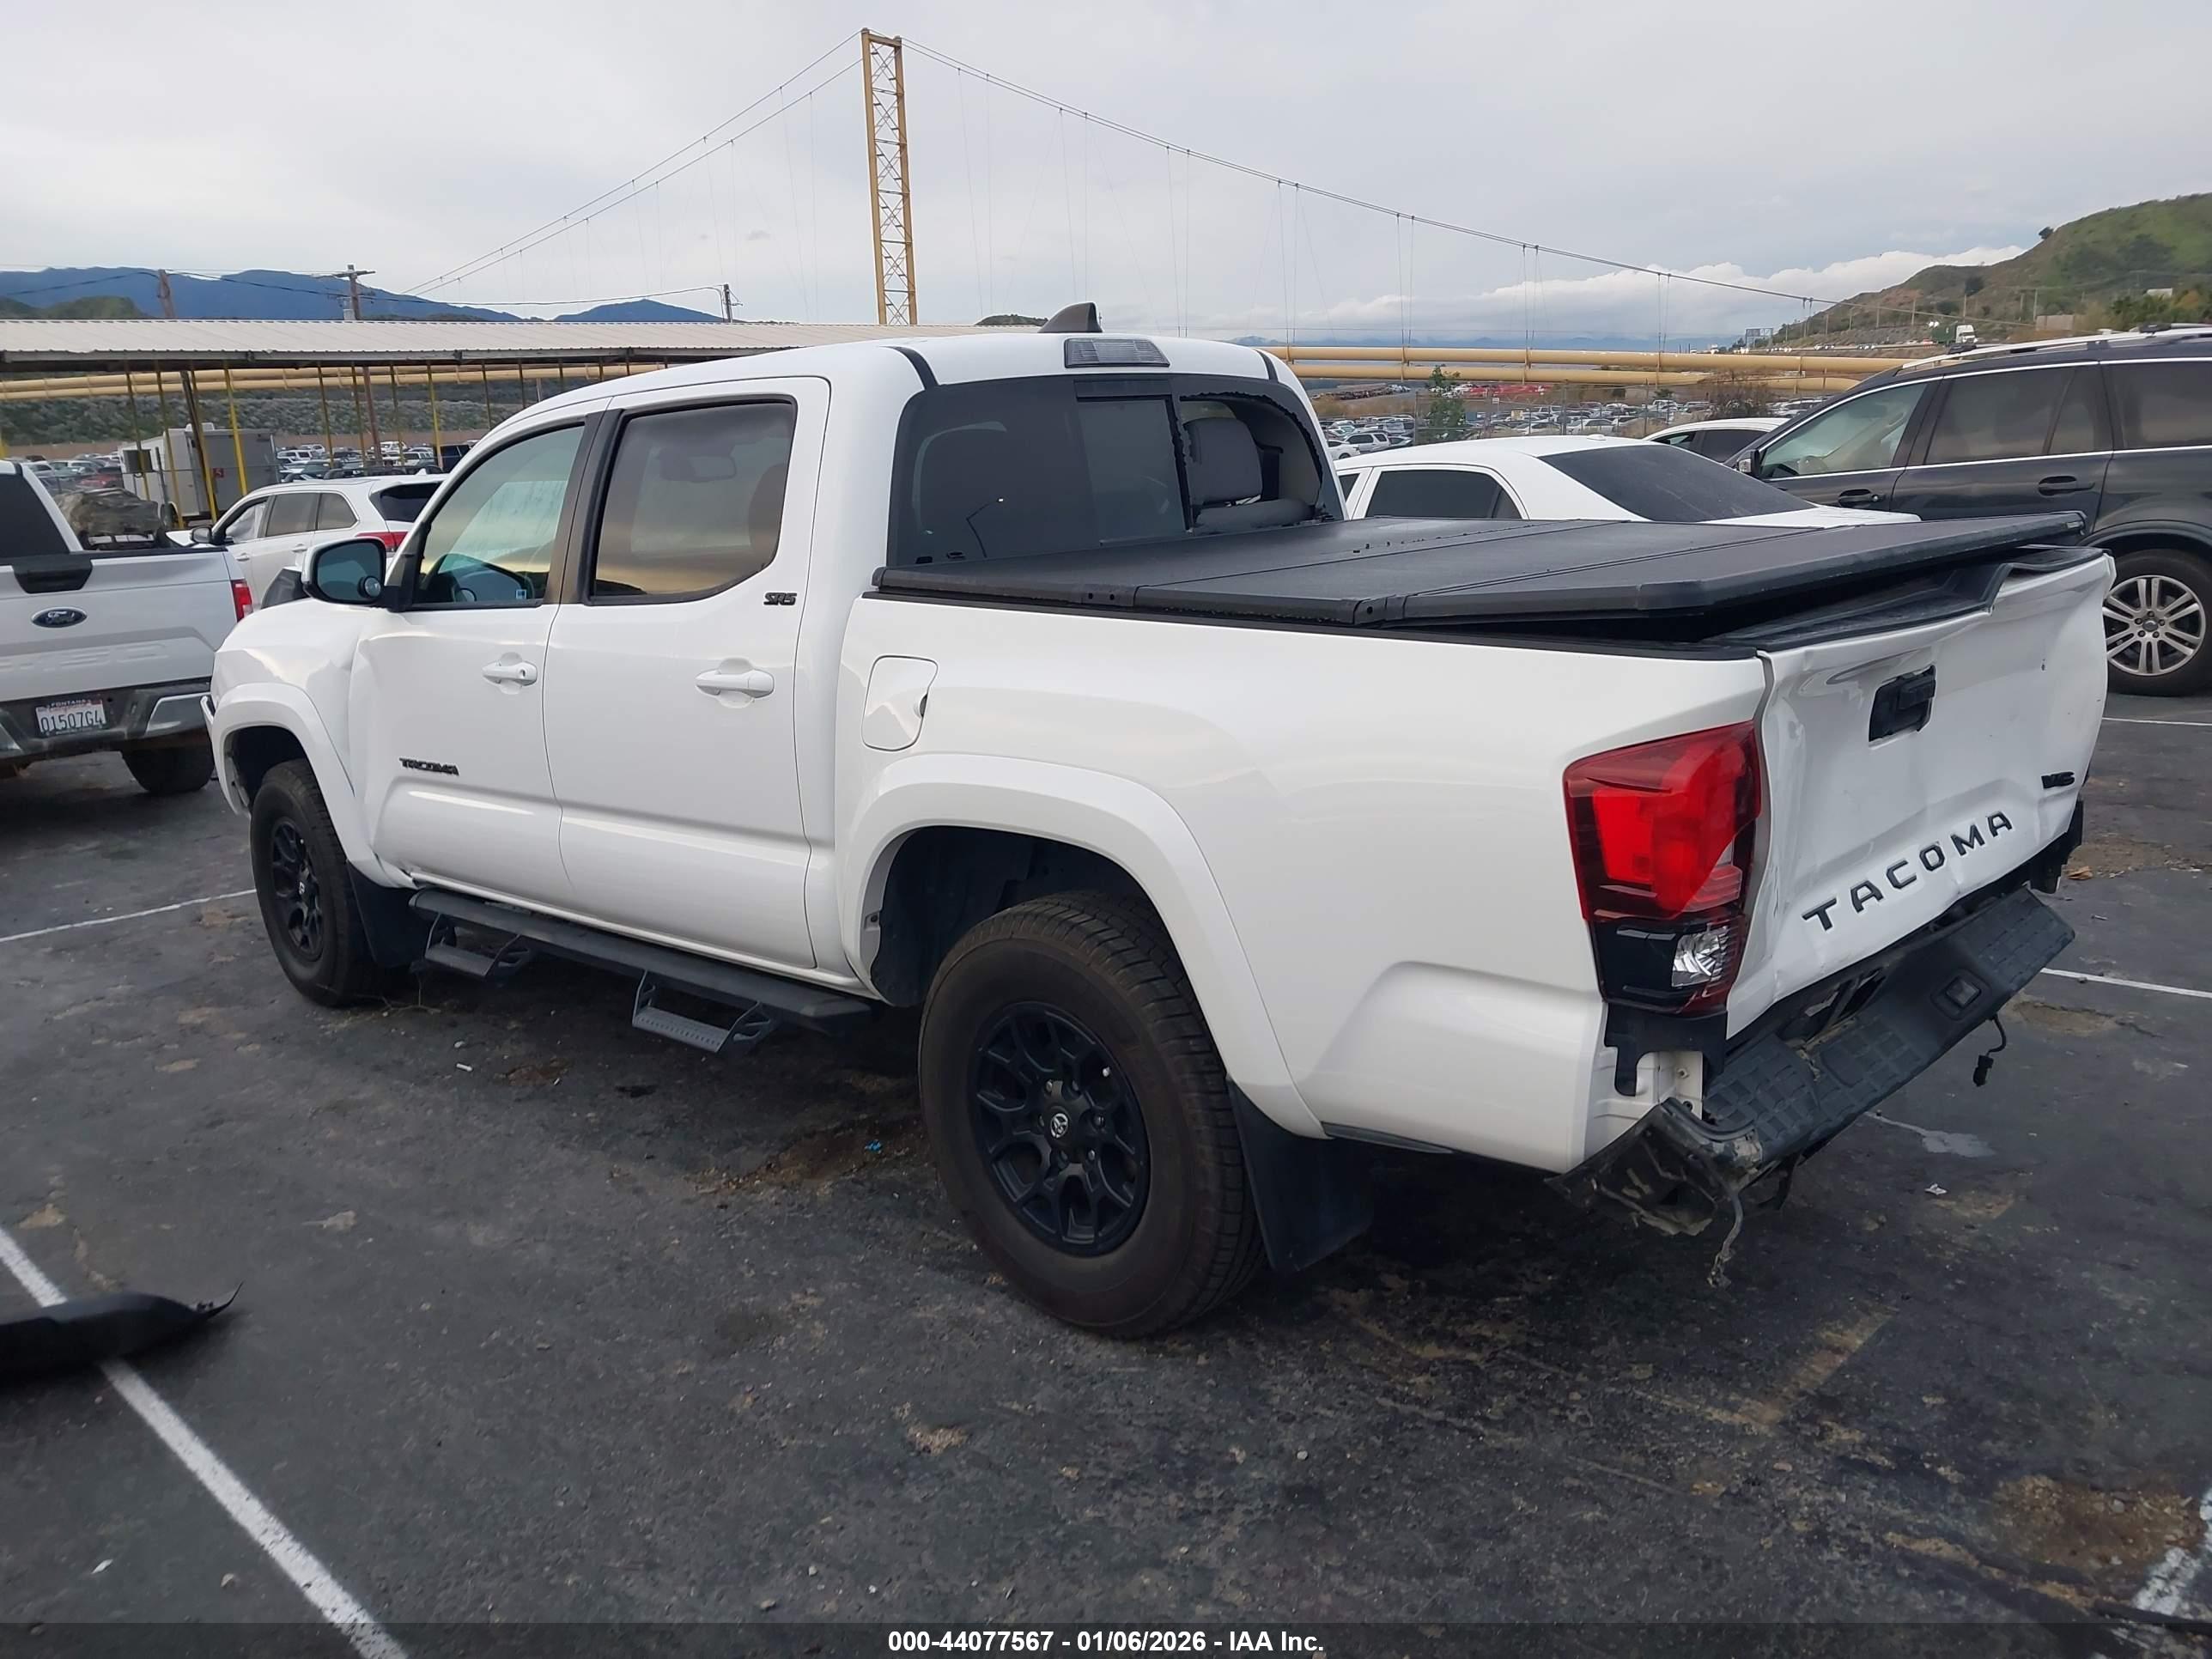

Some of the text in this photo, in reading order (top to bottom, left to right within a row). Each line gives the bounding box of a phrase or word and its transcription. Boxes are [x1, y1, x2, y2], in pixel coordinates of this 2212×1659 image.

[763, 592, 797, 605] SR5
[40, 710, 103, 733] 01507G4
[398, 757, 459, 776] TACOMA
[2041, 771, 2075, 789] V6
[1802, 811, 2013, 931] TACOMA
